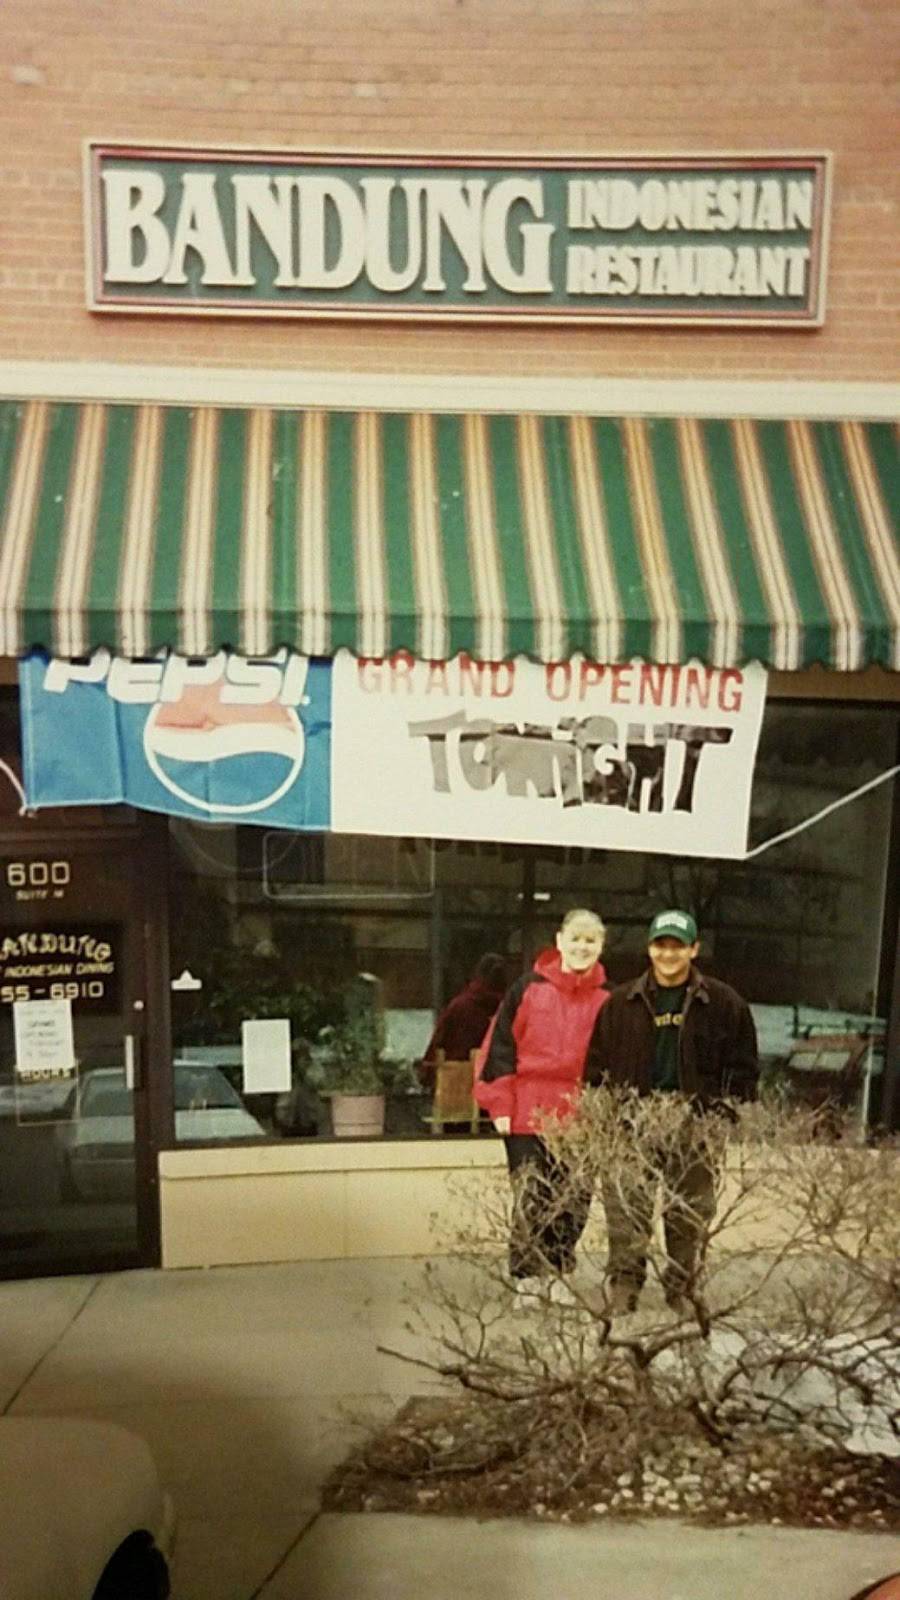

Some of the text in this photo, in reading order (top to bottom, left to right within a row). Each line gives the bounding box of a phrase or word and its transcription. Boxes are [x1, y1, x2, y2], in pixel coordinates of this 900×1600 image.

[102, 169, 554, 295] BANDUNG
[567, 178, 813, 232] INDONESIAN
[565, 244, 810, 297] RESTAURANT
[357, 650, 744, 712] GRAND OPENING
[407, 708, 734, 814] TONIGHT
[7, 861, 71, 887] 600
[4, 963, 75, 978] INDONESIAN
